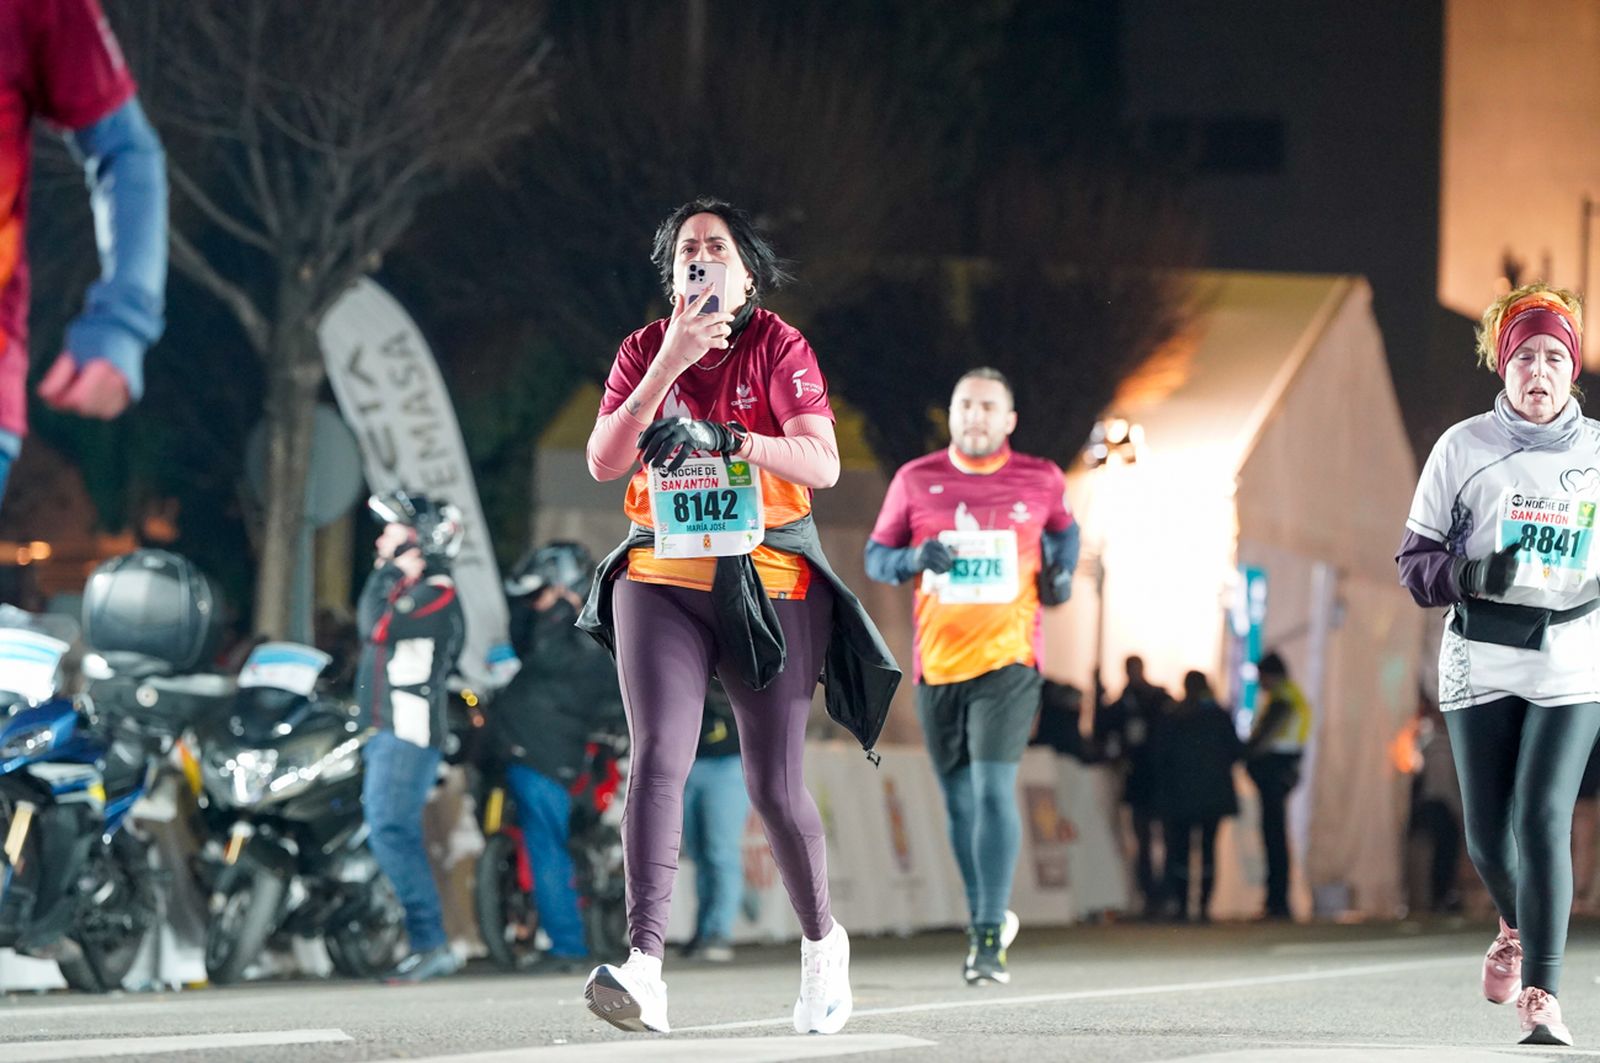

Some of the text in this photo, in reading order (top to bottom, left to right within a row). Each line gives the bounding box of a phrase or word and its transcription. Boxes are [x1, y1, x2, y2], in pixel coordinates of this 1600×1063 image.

[671, 466, 703, 478] NOCHE
[705, 466, 717, 476] DE
[661, 480, 682, 491] SAN
[673, 489, 738, 523] 8142
[1524, 500, 1556, 511] NOCHE
[1558, 503, 1570, 513] DE
[1510, 510, 1533, 521] SAN
[686, 522, 726, 532] MARÍA JOSÉ
[1520, 523, 1581, 558] 8841
